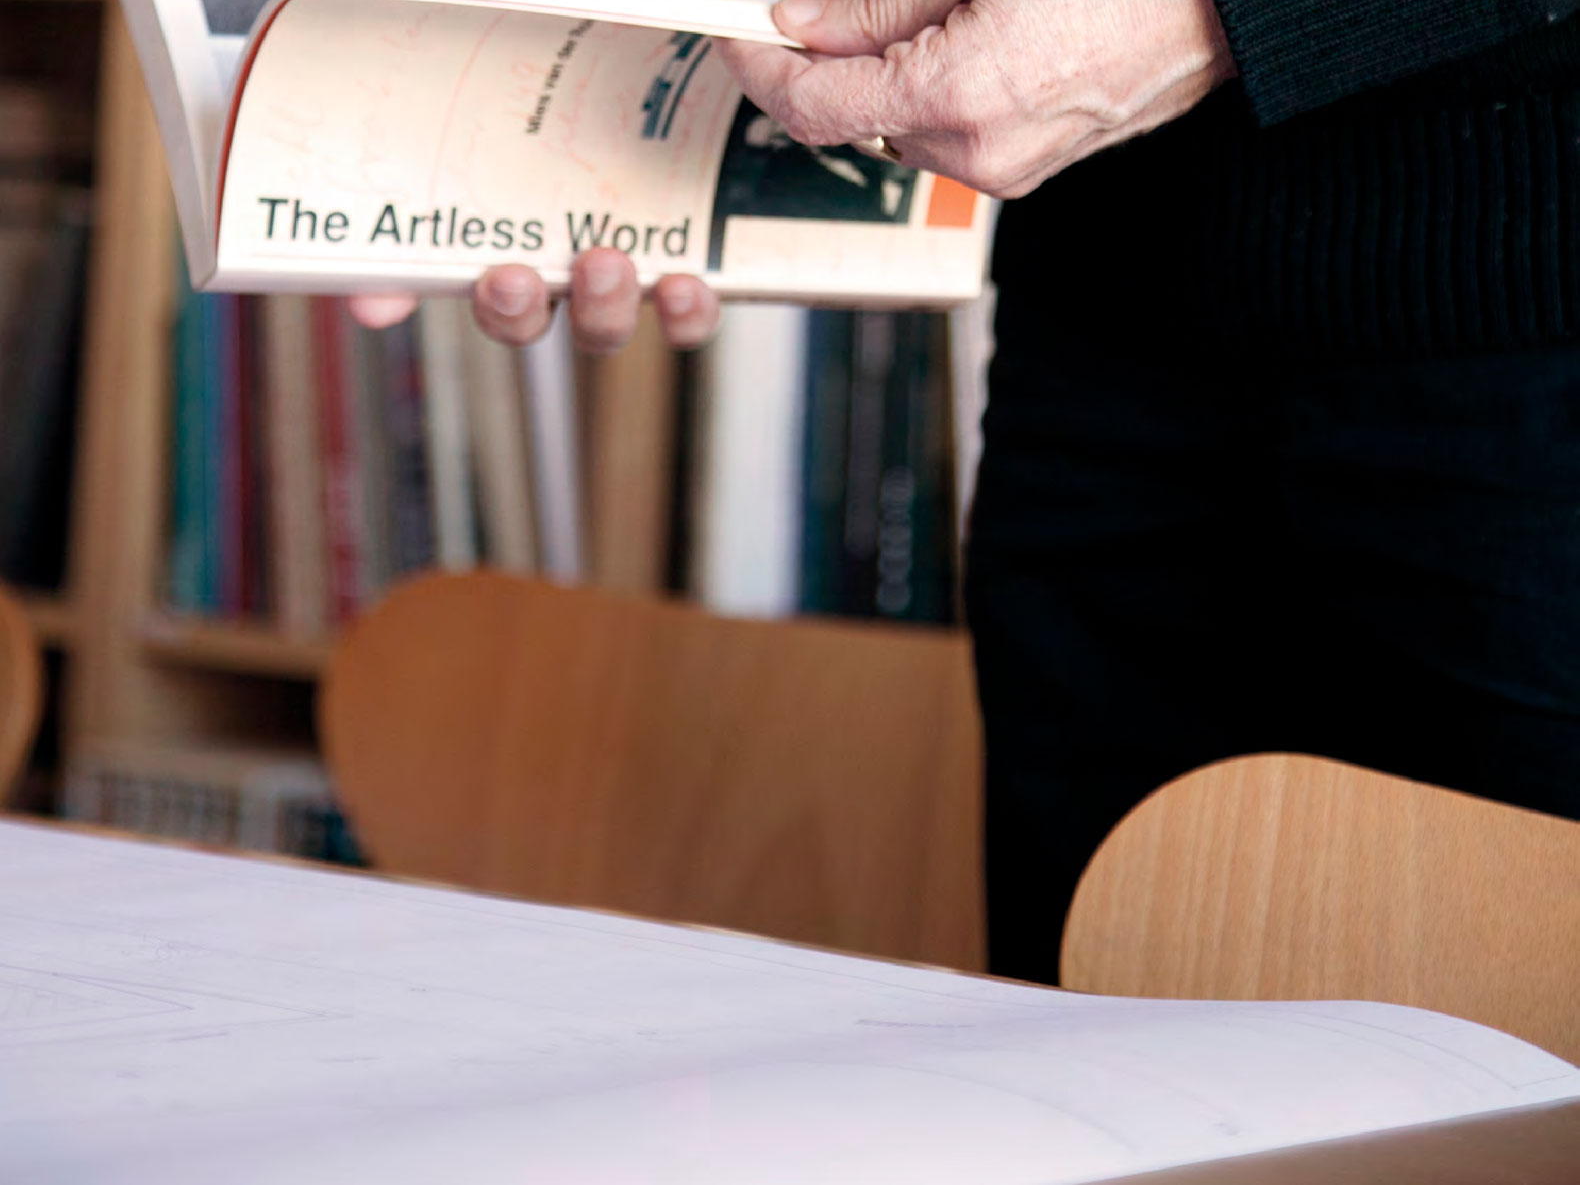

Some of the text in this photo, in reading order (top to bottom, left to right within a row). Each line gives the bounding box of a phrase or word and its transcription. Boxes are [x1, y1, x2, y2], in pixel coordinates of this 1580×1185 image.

[258, 197, 691, 257] The Artless Word
